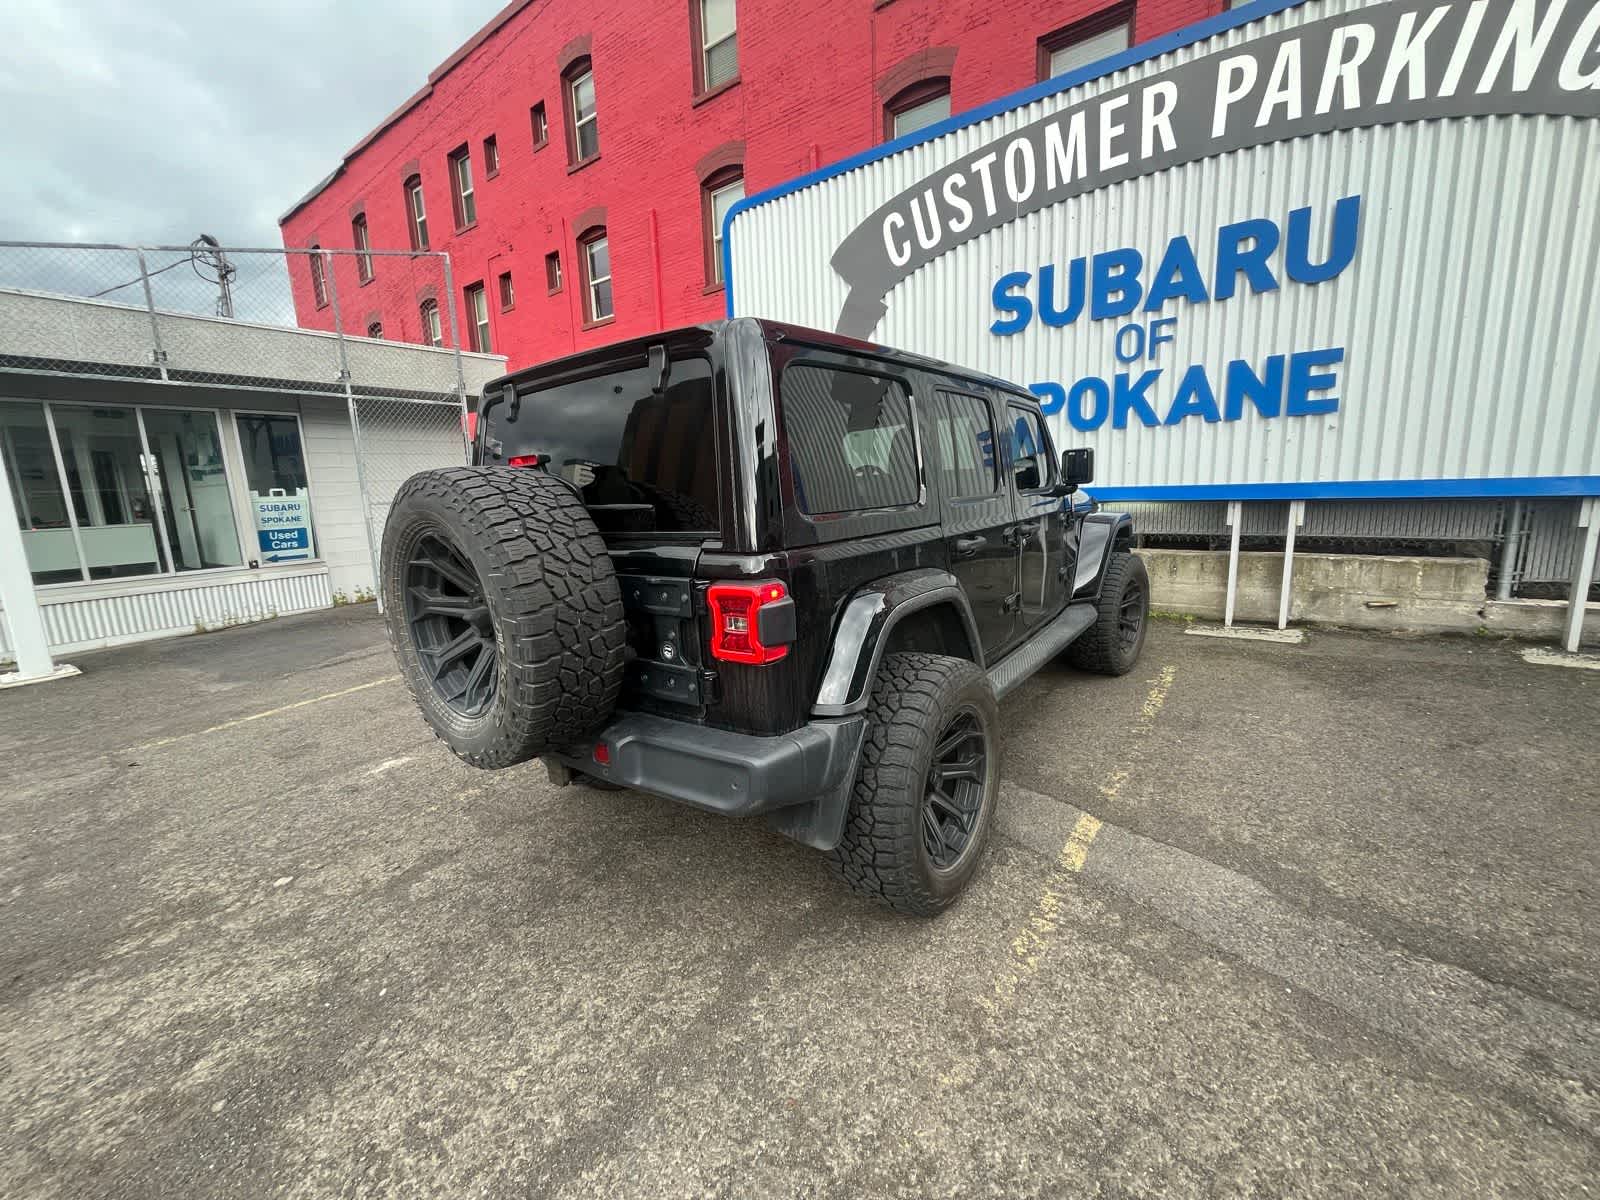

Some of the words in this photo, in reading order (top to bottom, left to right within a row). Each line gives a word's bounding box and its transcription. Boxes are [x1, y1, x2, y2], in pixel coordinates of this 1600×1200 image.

[882, 80, 1178, 267] CUSTOMER
[990, 195, 1361, 337] SUBARU
[1115, 316, 1178, 364] OF
[1028, 347, 1344, 433] POKANE
[259, 503, 301, 512] SUBARU
[261, 515, 303, 524] SPOKANE
[269, 530, 299, 540] Used
[271, 540, 299, 549] Cars
